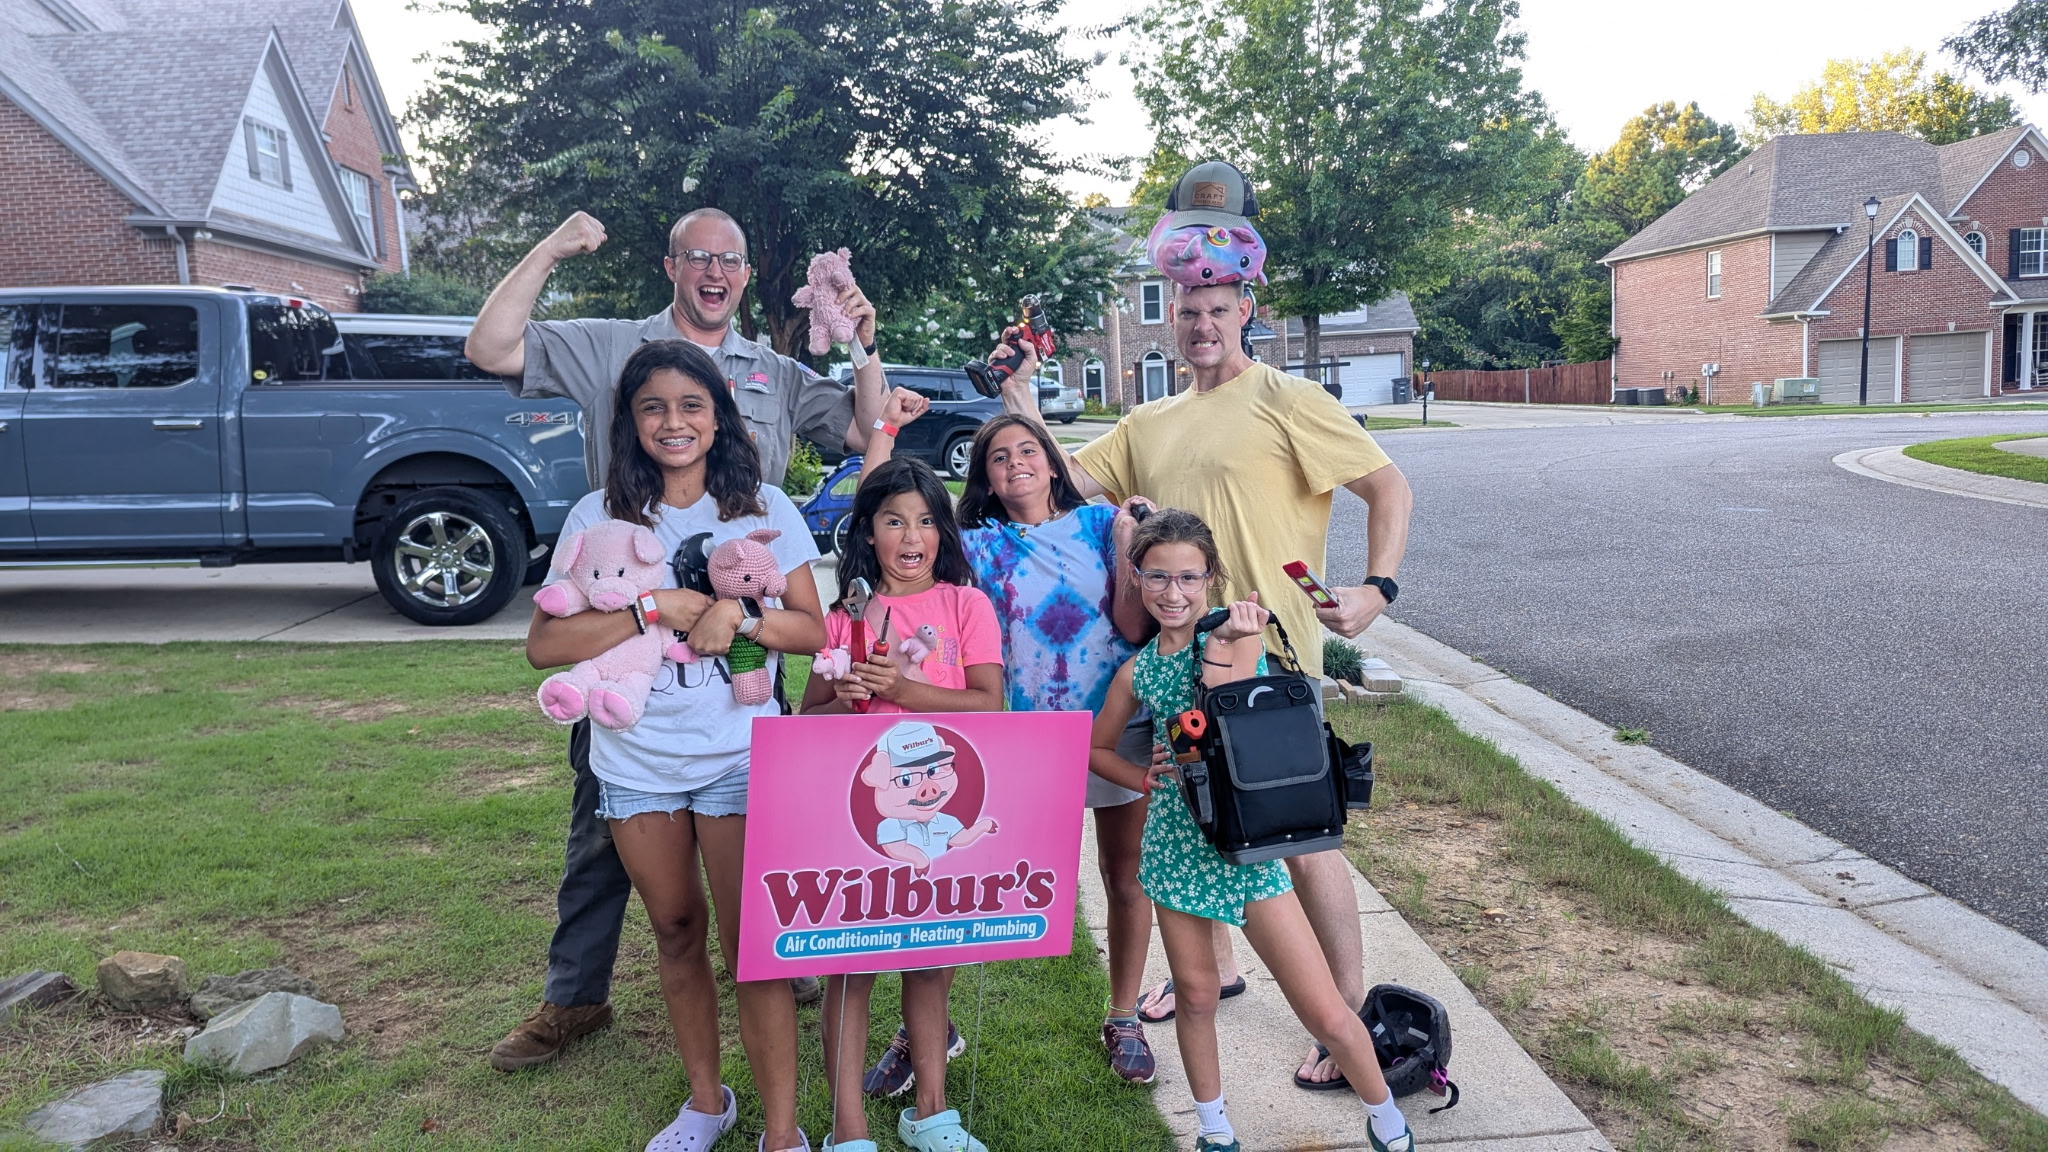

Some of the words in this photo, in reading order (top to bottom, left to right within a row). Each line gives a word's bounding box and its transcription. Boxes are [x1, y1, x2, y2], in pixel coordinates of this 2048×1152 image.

[1194, 193, 1224, 201] CRAFT
[901, 737, 934, 751] Wilbur's
[763, 860, 1056, 927] Wilbur's
[784, 935, 806, 953] Air
[809, 928, 902, 951] Conditioning
[909, 925, 965, 944] Heating
[972, 920, 1037, 939] Plumbing
